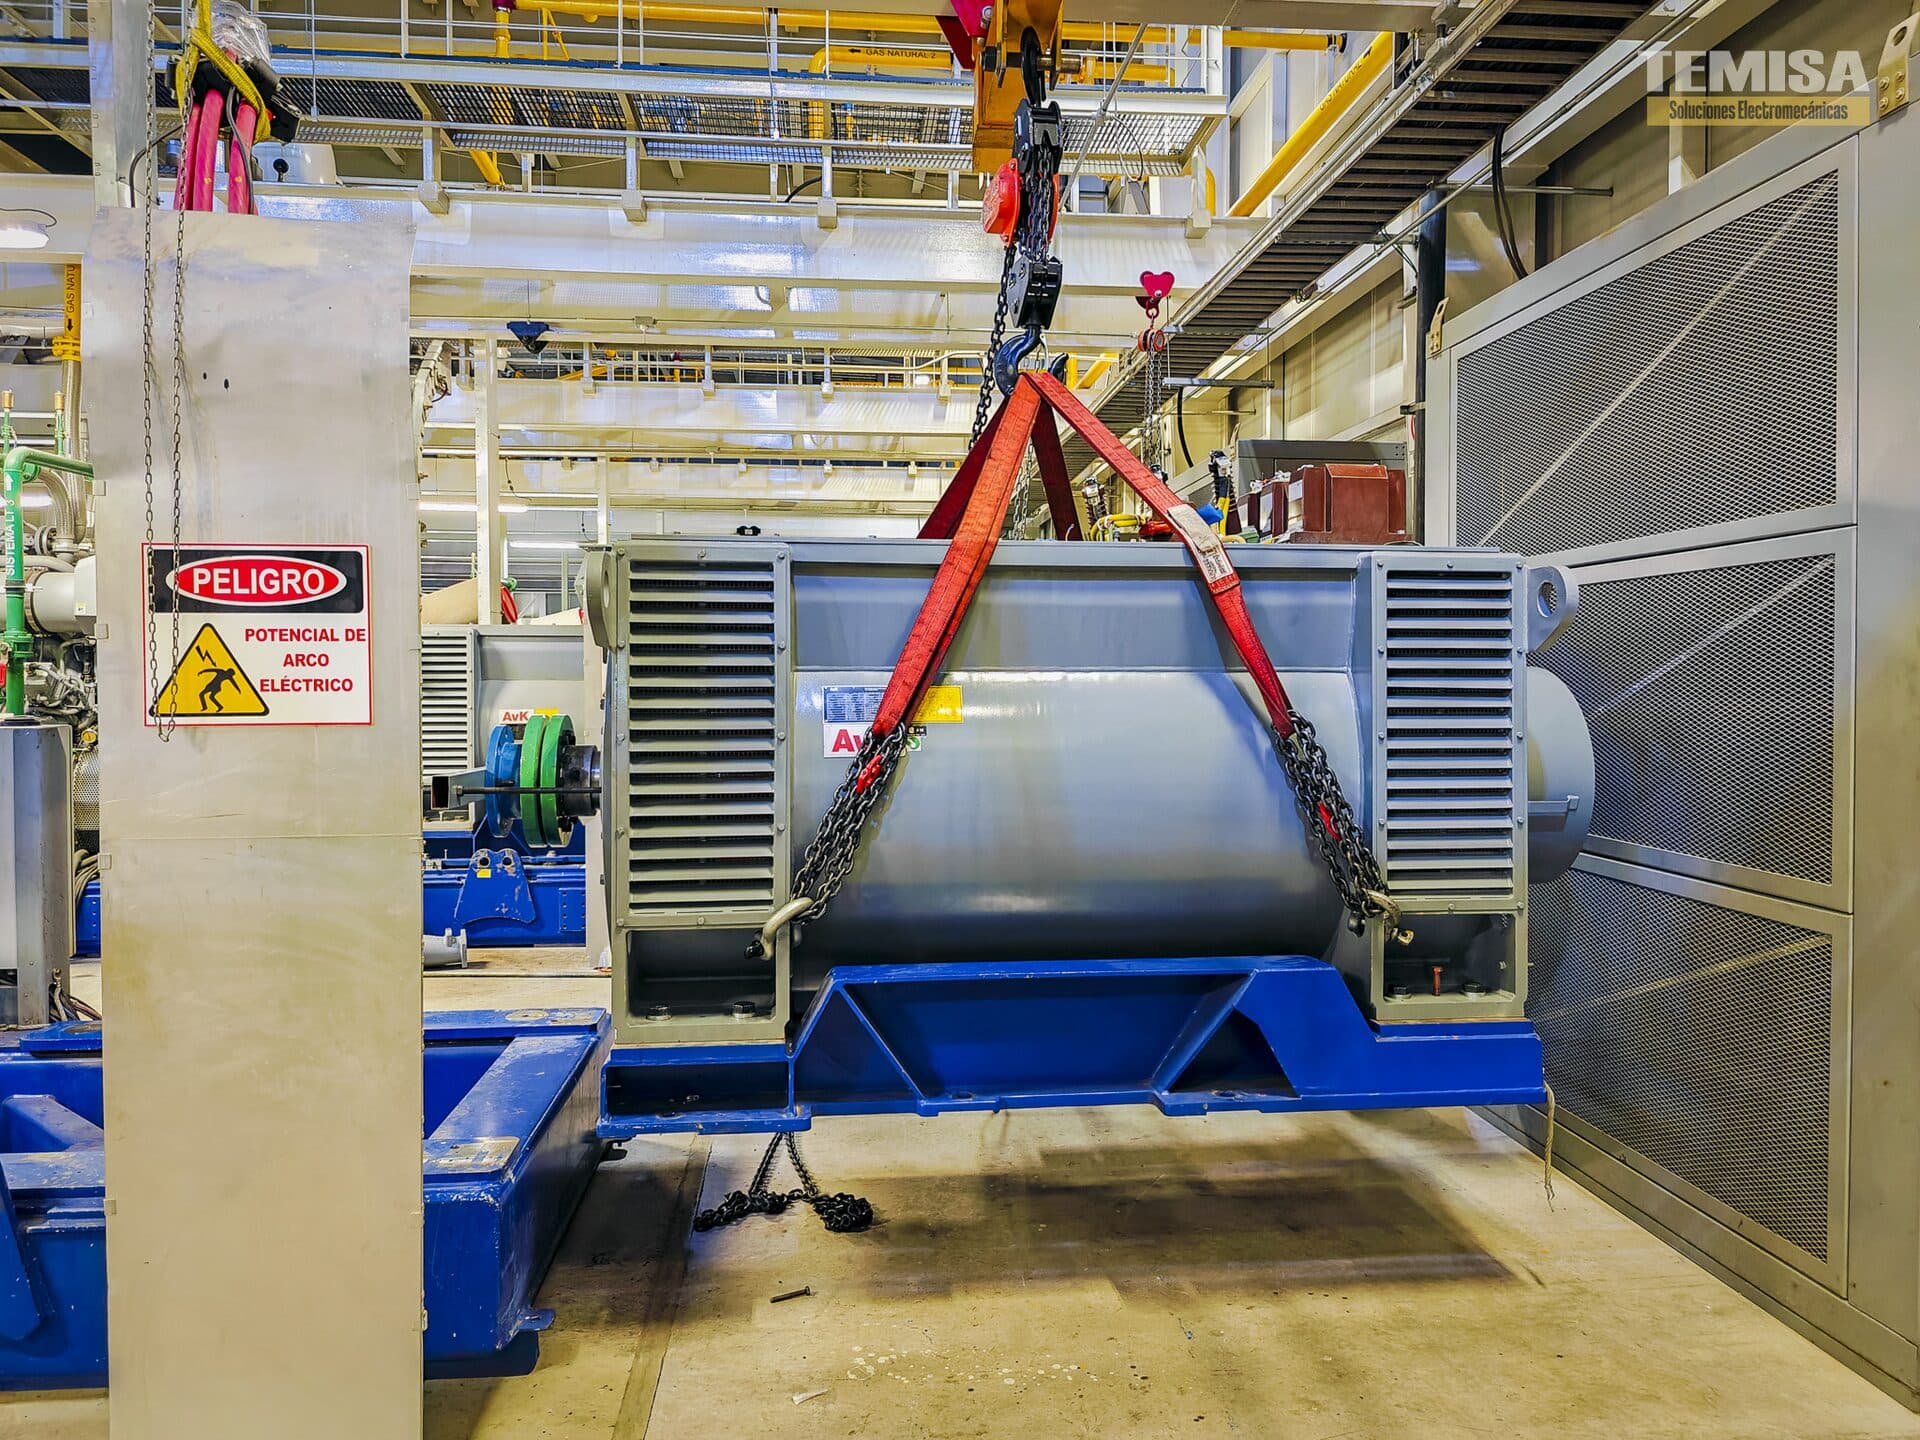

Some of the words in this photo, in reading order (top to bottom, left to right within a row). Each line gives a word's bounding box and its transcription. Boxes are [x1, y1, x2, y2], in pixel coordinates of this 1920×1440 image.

[865, 48, 886, 57] GAS
[887, 50, 928, 58] NATURAL
[66, 265, 75, 290] NATU
[66, 293, 75, 313] GAS
[6, 524, 15, 577] SISTEMA
[193, 567, 326, 596] PELIGRO
[245, 628, 339, 642] POTENCIAL
[345, 628, 366, 642] DE
[283, 653, 330, 667] ARCO
[259, 676, 354, 692] ELÉCTRICO
[502, 711, 529, 721] AvK
